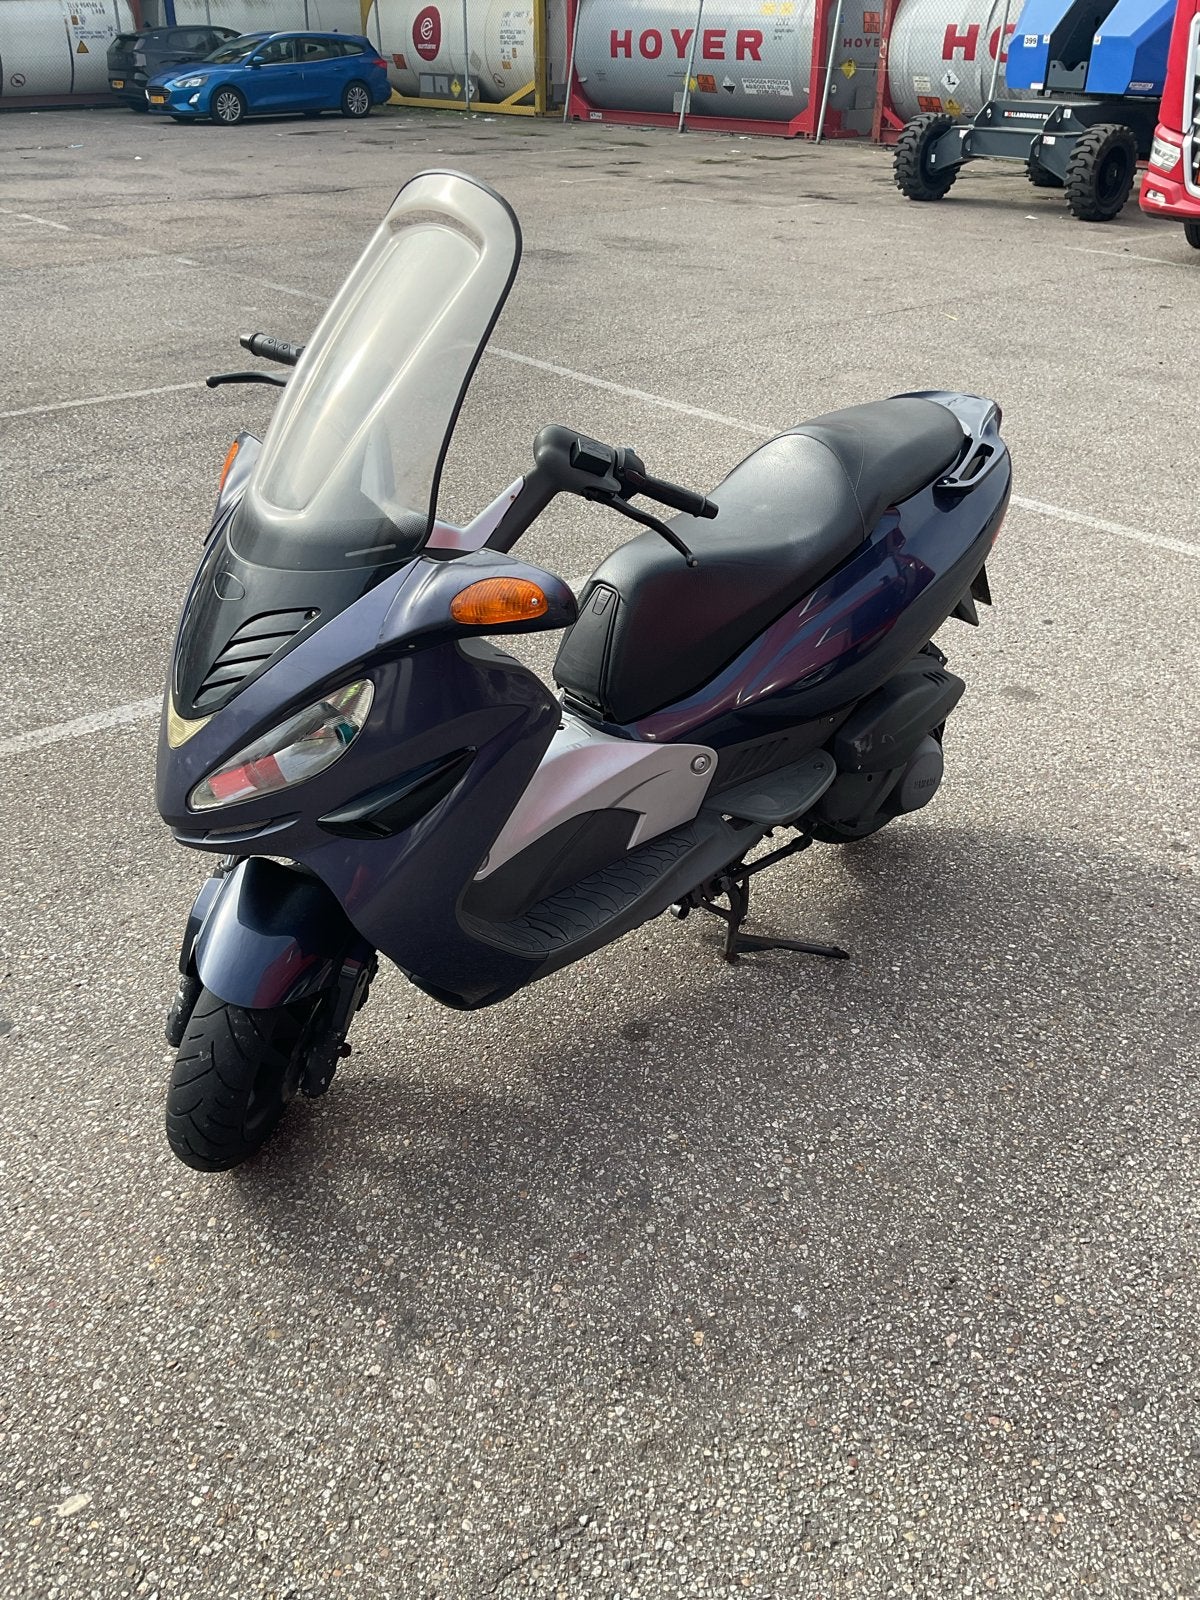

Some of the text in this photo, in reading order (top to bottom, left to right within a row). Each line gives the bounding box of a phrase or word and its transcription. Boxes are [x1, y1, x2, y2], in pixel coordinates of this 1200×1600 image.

[611, 29, 762, 60] HOYER
[843, 38, 882, 48] HOYE
[1025, 37, 1037, 45] 399
